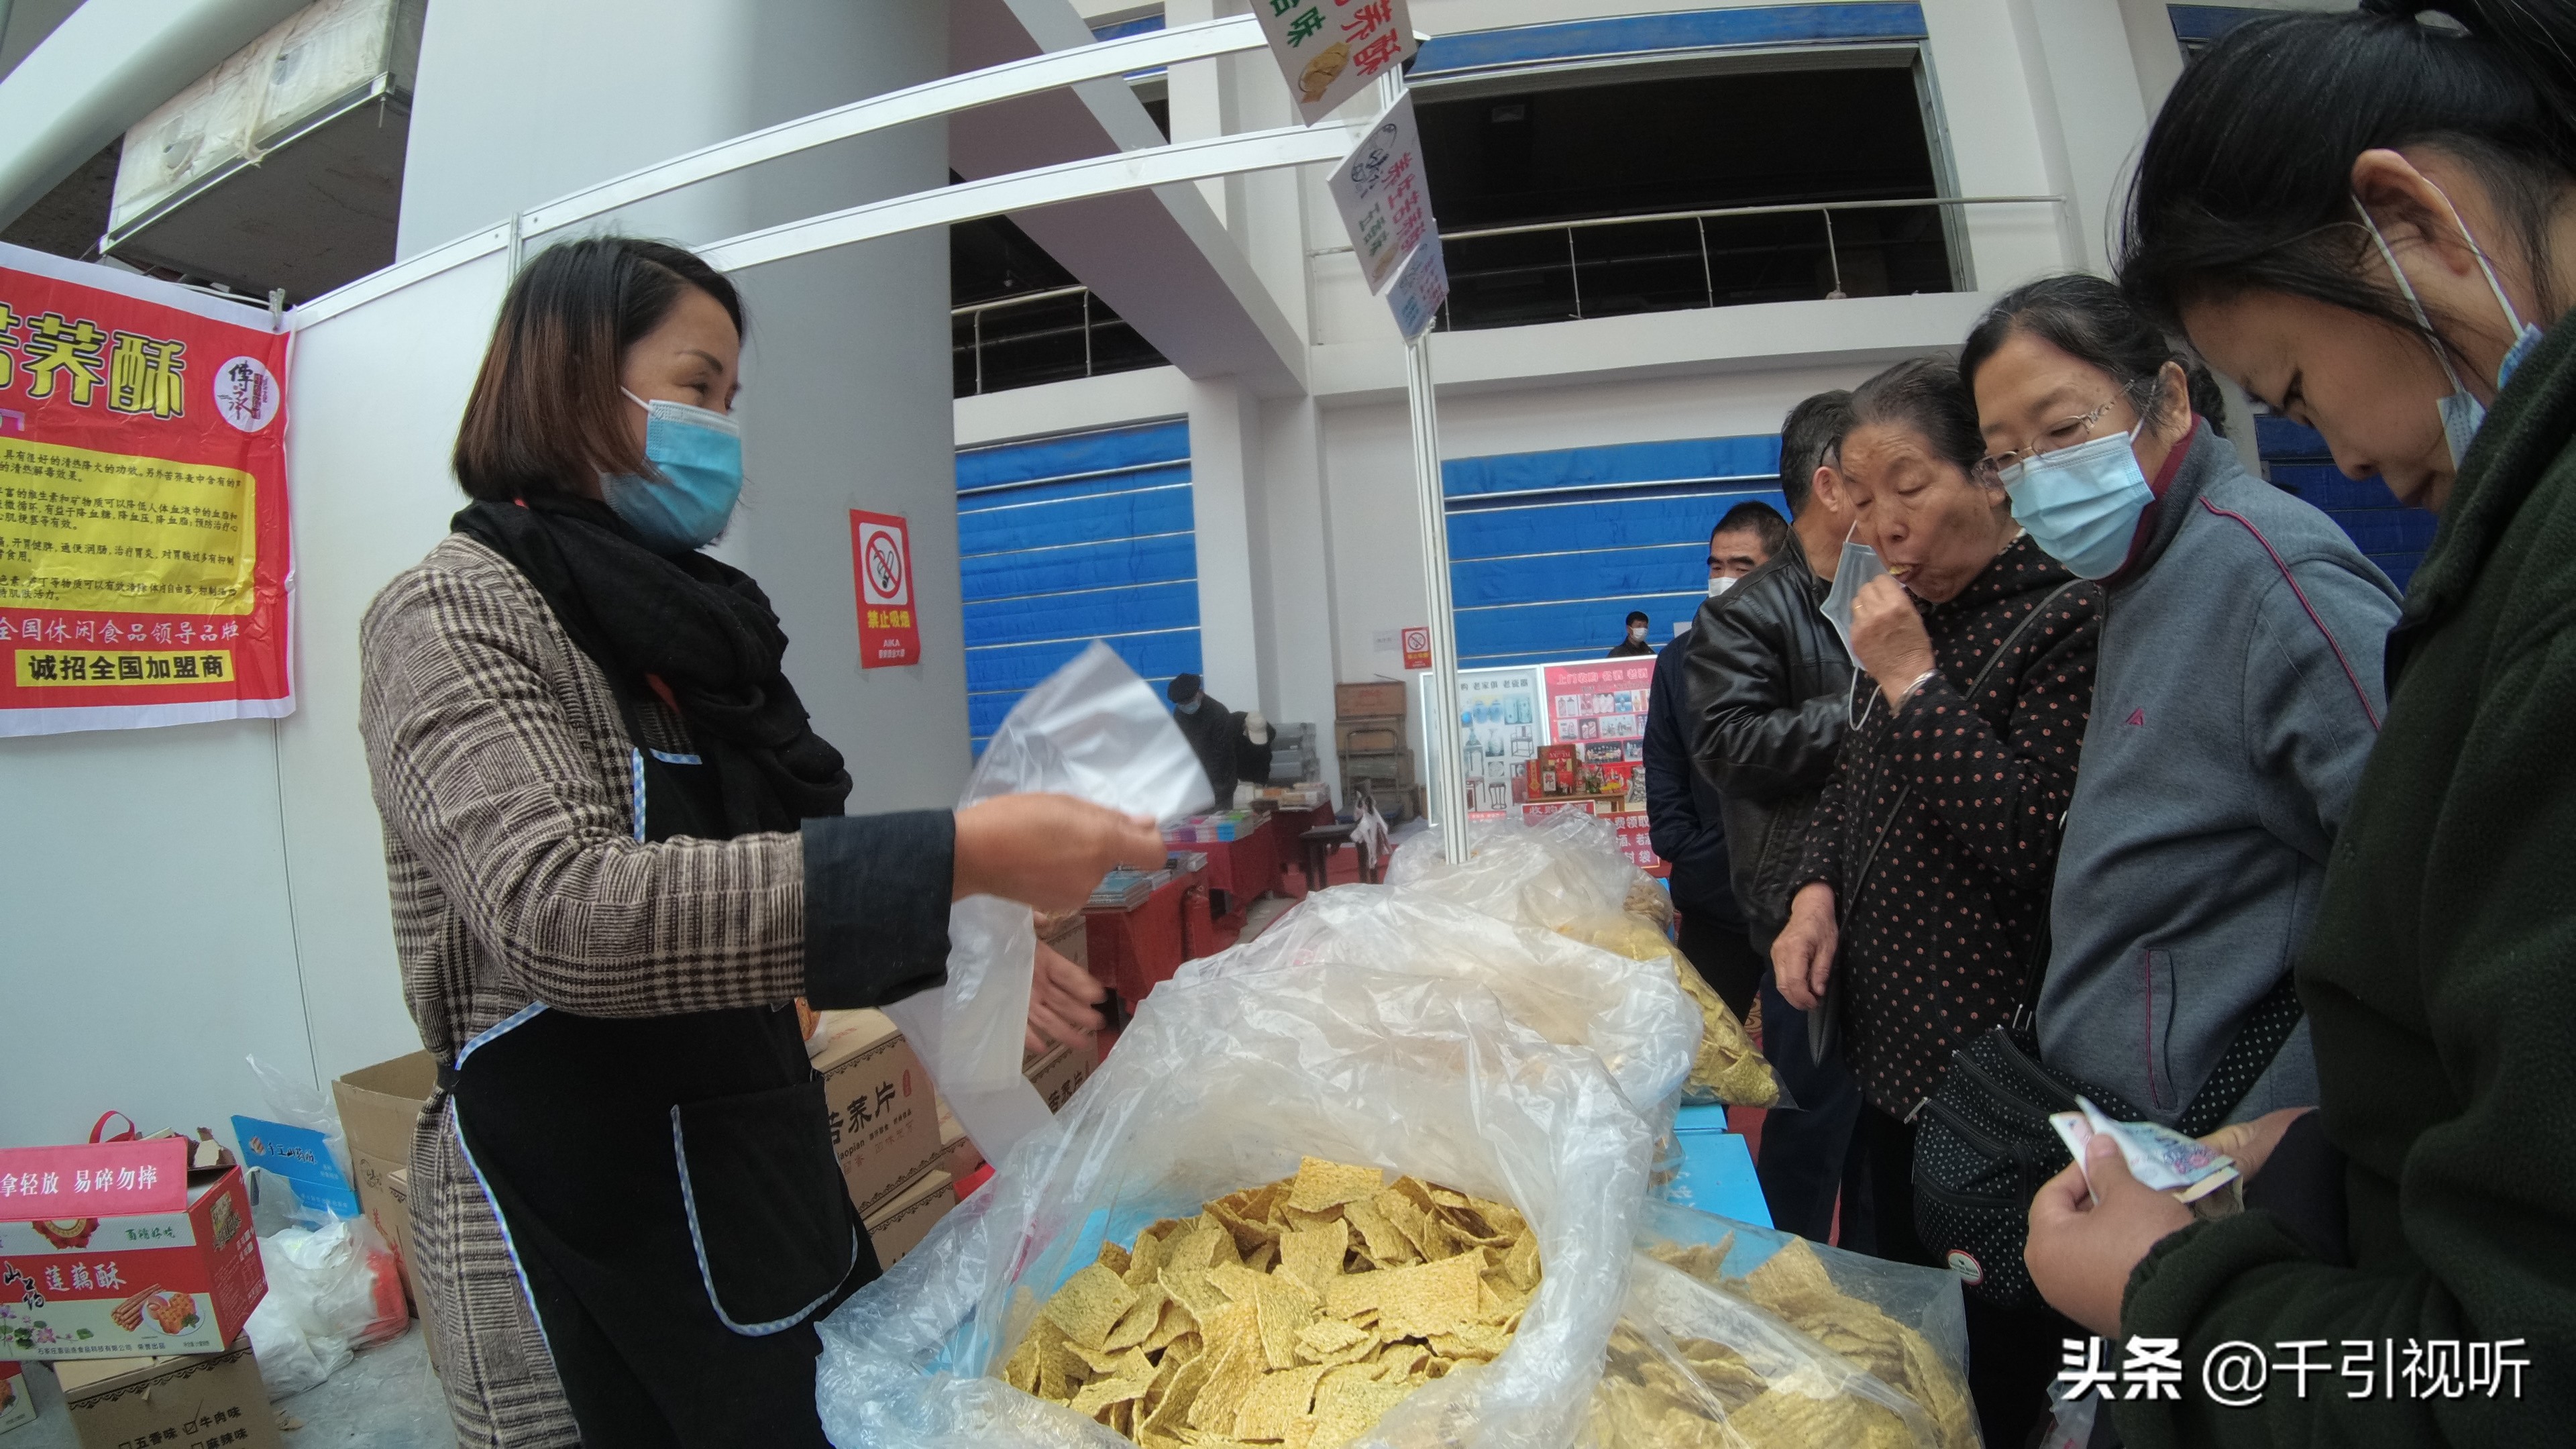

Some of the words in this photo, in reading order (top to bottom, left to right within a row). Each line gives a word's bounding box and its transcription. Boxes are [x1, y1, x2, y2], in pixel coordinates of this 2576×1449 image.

[1334, 0, 1401, 76] 荞酥
[28, 654, 224, 681] 诚招全国加盟商
[74, 1165, 158, 1193] 易碎勿摔
